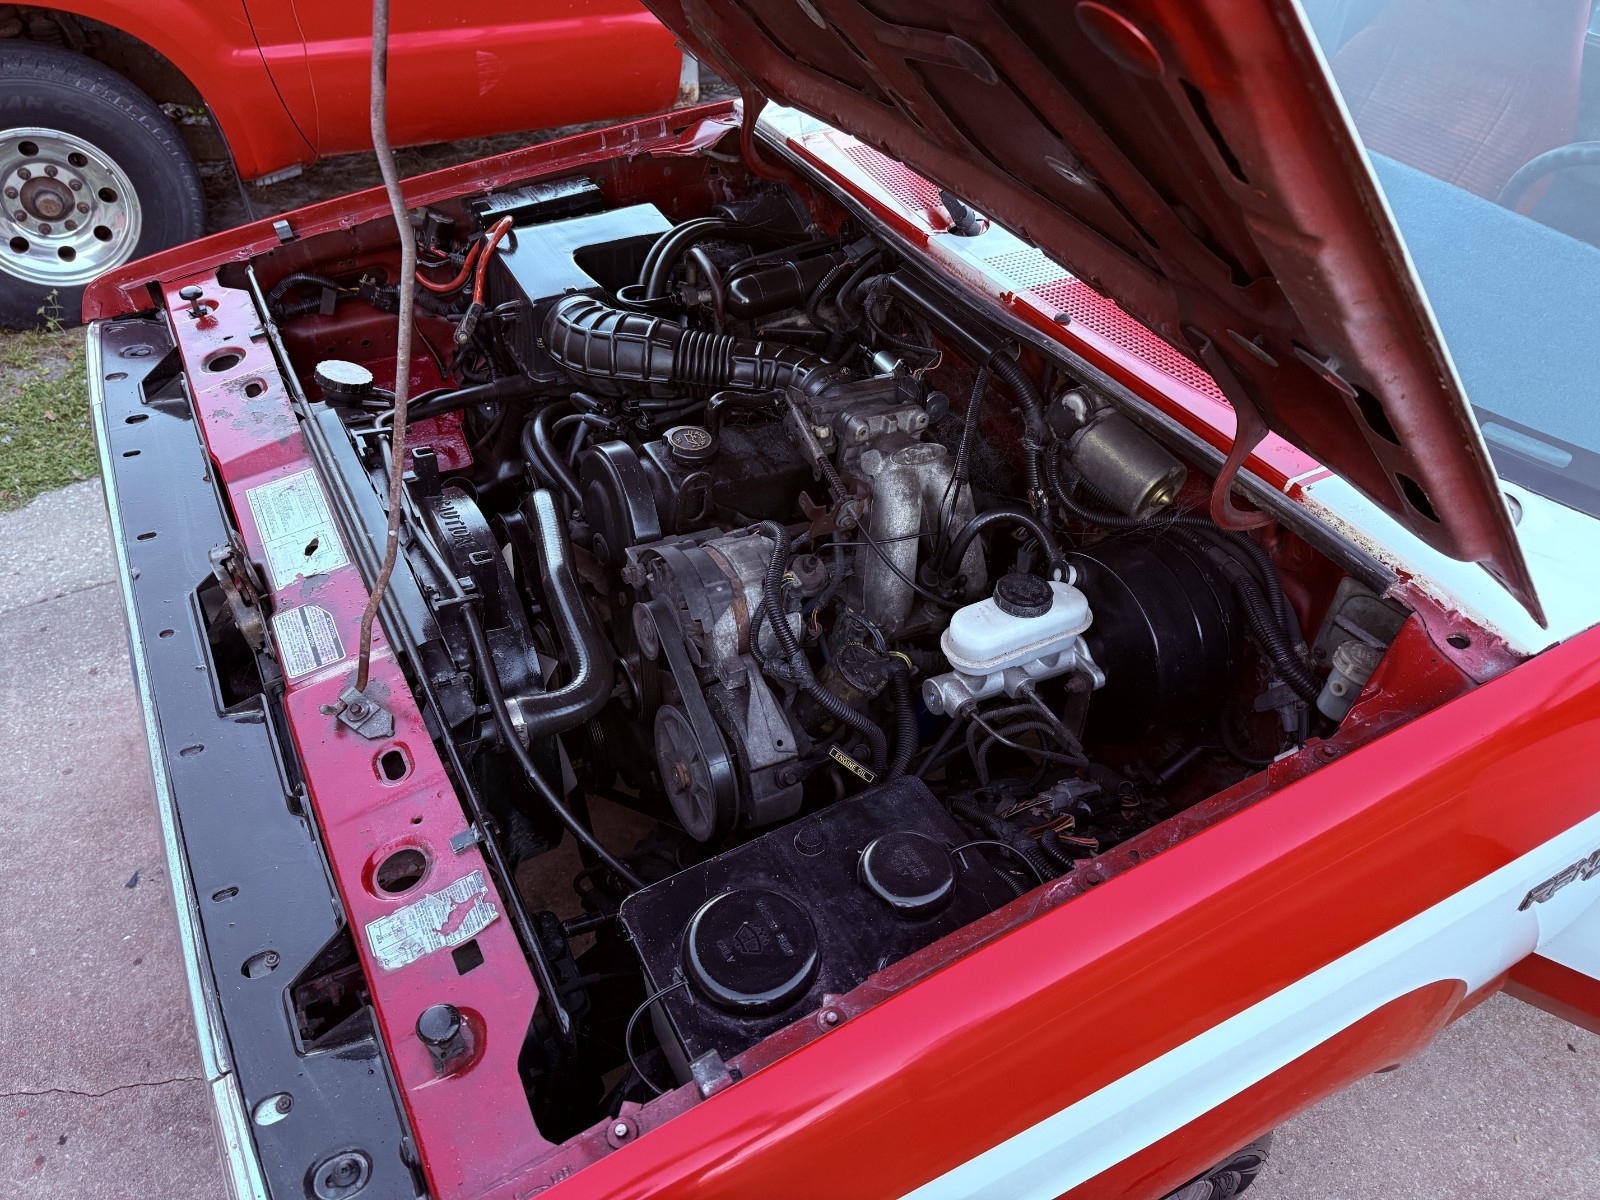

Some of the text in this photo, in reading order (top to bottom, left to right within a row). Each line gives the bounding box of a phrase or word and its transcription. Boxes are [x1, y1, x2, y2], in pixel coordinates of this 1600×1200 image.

[835, 751, 857, 771] ENGINE
[755, 899, 795, 957] WASHER FLUID
